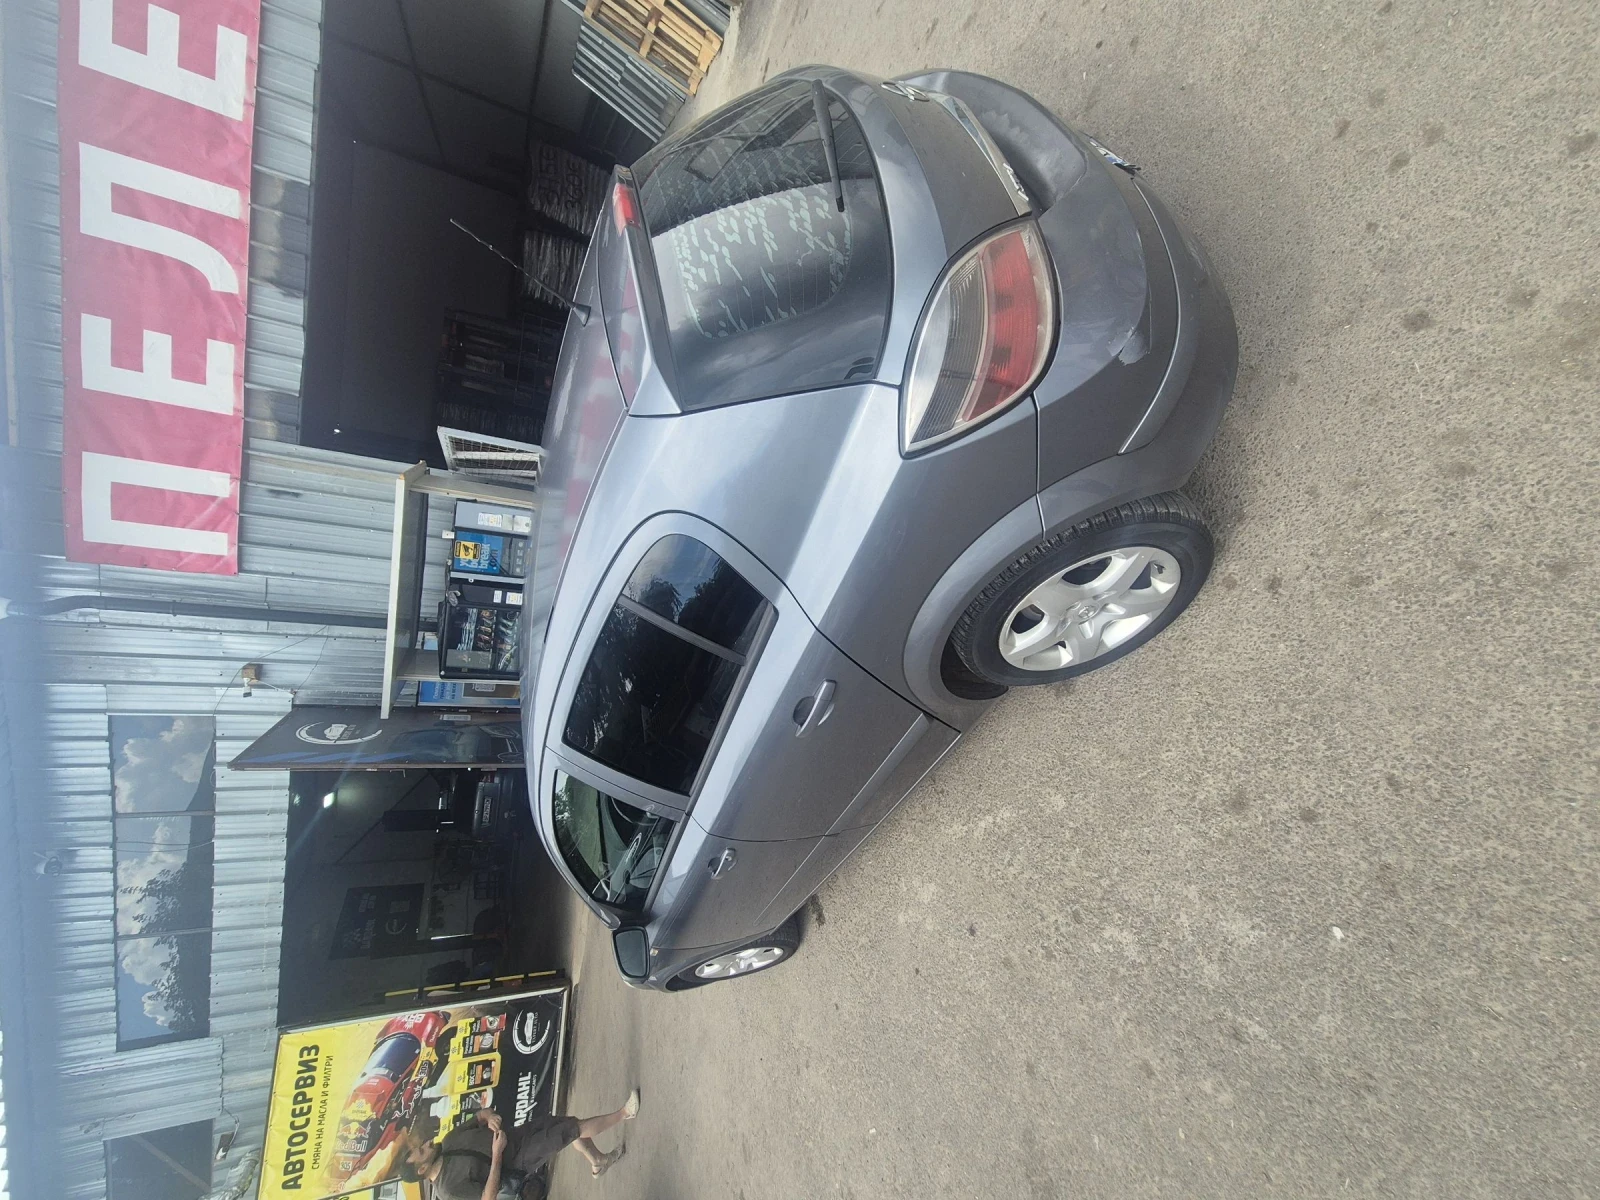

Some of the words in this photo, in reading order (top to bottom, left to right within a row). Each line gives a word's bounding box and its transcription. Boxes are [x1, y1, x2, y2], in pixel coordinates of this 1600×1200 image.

[78, 0, 248, 556] ПЕЛЕ
[479, 544, 490, 569] break
[322, 1055, 334, 1088] ФИЛТРИ
[318, 1099, 328, 1126] МАСЛА
[514, 1072, 537, 1127] ARDAHL
[281, 1044, 320, 1190] АВТОСЕРВИЗ
[315, 1128, 324, 1139] НА
[311, 1141, 323, 1170] СМЯНА
